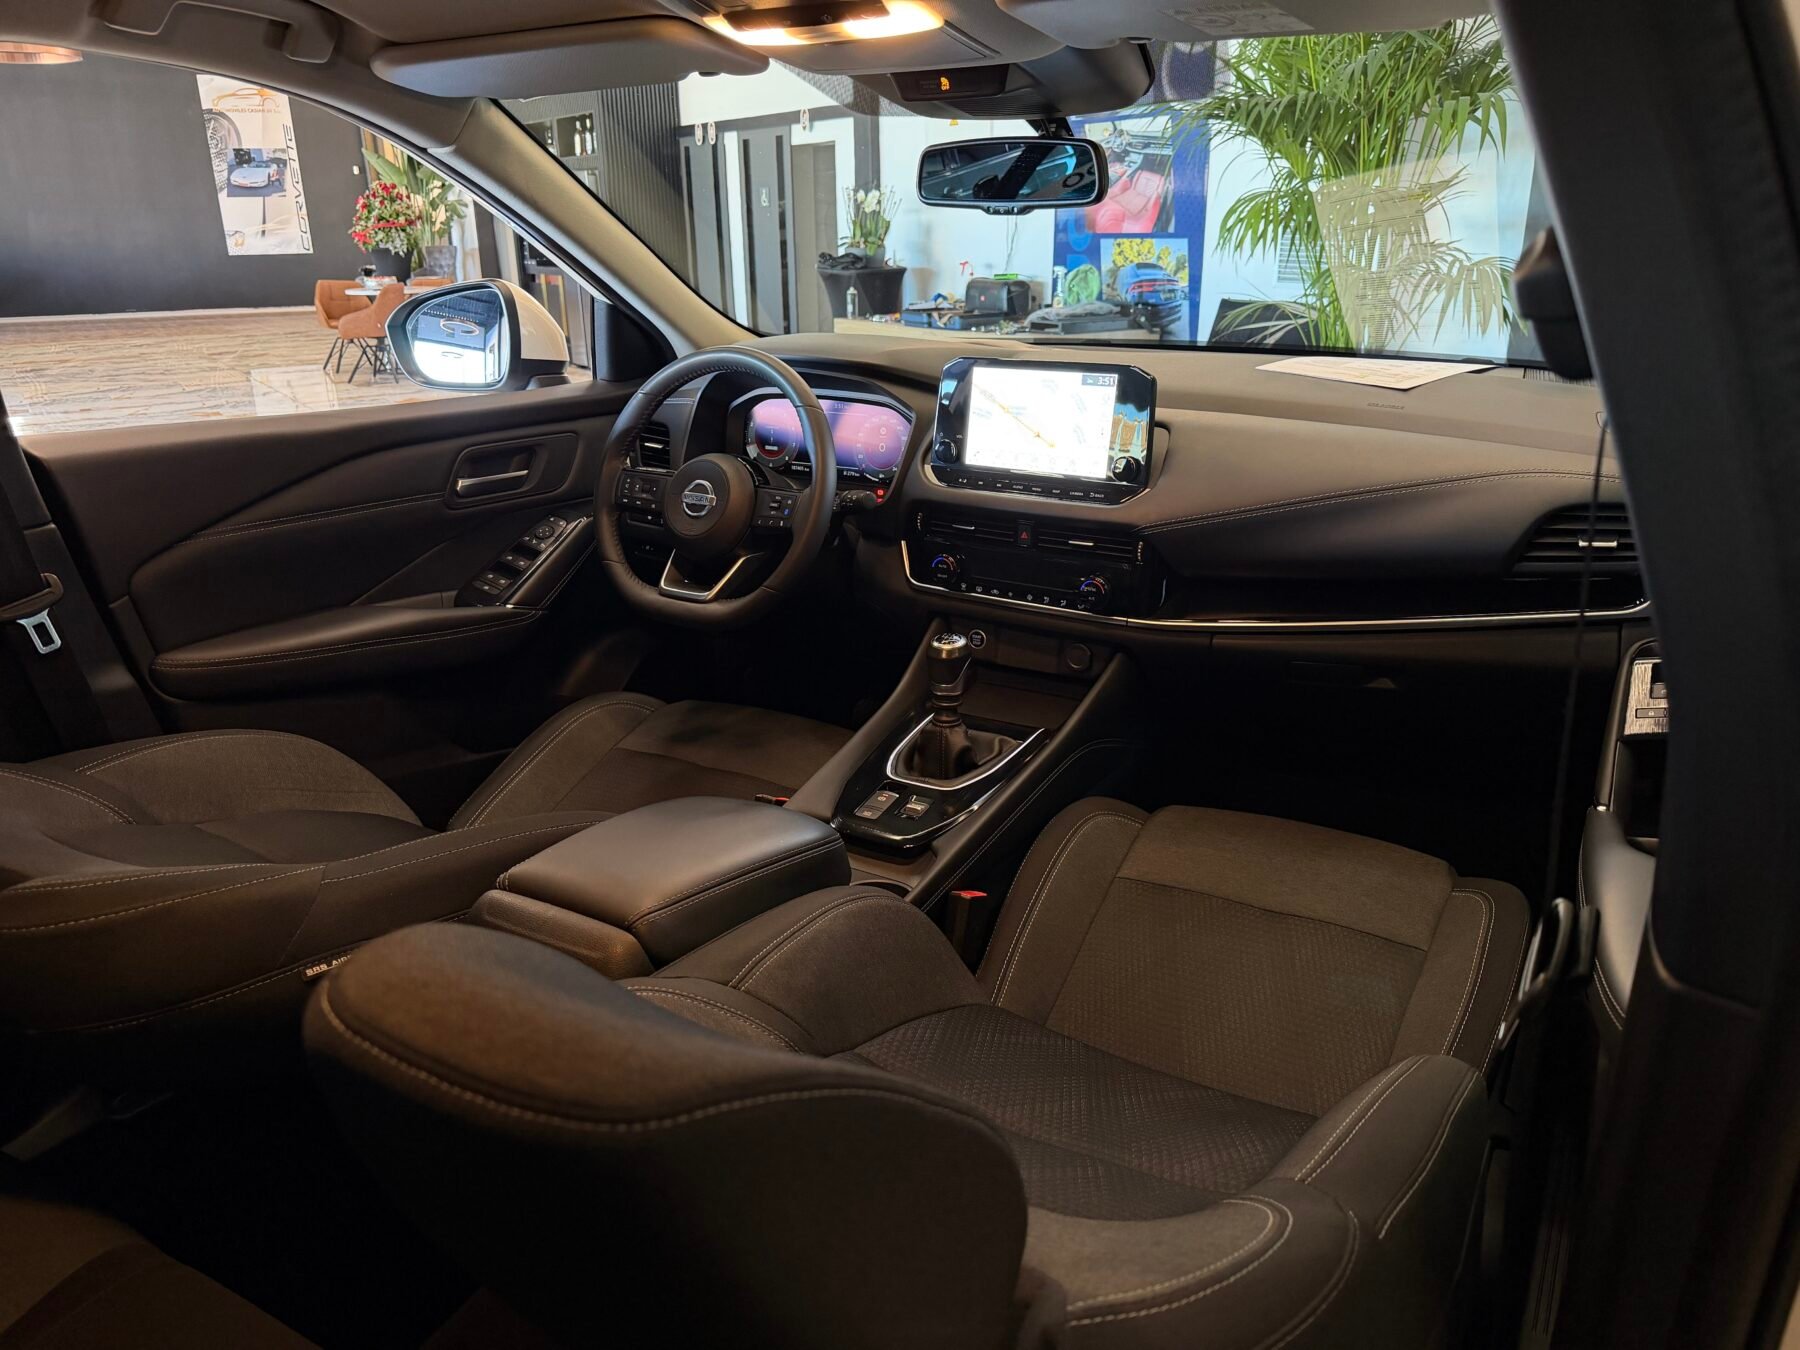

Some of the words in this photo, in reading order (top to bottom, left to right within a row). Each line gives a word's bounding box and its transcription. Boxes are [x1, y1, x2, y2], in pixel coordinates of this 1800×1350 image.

[282, 123, 310, 251] CORVETTE
[1097, 376, 1114, 386] 3:51
[305, 963, 328, 977] SRS
